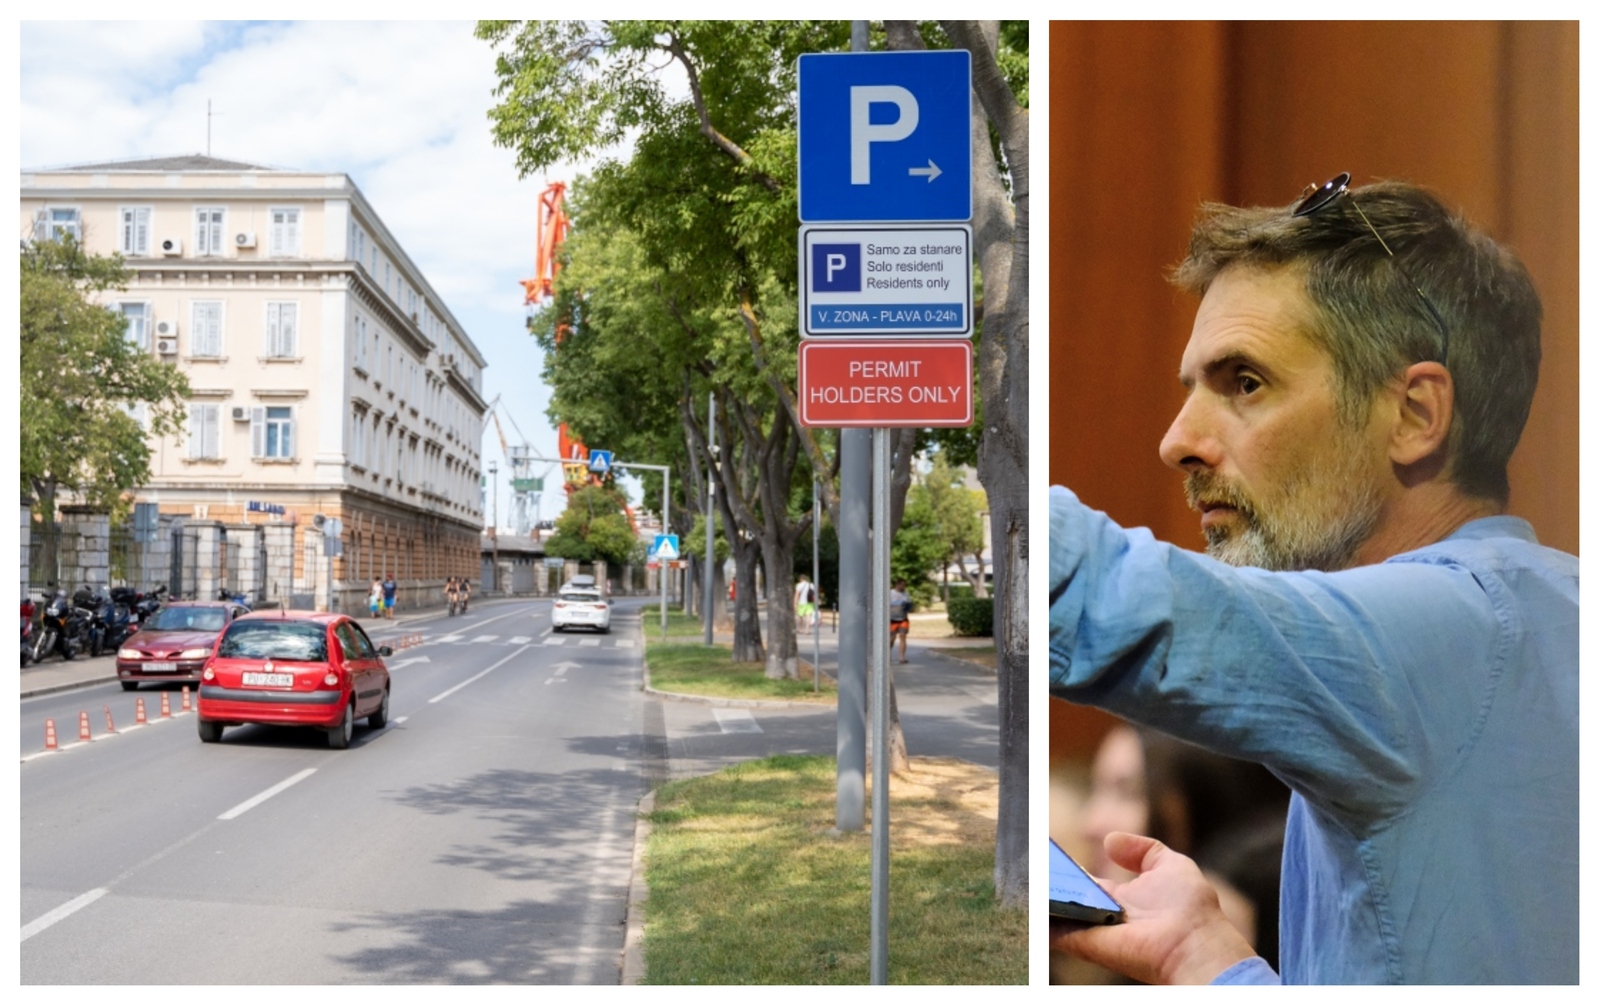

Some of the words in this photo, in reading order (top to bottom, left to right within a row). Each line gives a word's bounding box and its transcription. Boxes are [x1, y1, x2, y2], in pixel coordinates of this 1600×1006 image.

[850, 85, 920, 185] P
[866, 243, 901, 256] Samo
[903, 245, 917, 256] za
[920, 244, 963, 256] stanare
[826, 253, 847, 283] P
[866, 260, 893, 272] Solo
[895, 260, 944, 272] residenti
[866, 277, 924, 289] Residents
[926, 276, 950, 291] only
[818, 311, 831, 323] V.
[833, 310, 870, 323] ZONA
[880, 310, 922, 322] PLAVA
[924, 310, 958, 322] 0-24h
[849, 360, 922, 378] PERMIT
[810, 386, 904, 404] HOLDERS
[908, 386, 961, 404] ONLY
